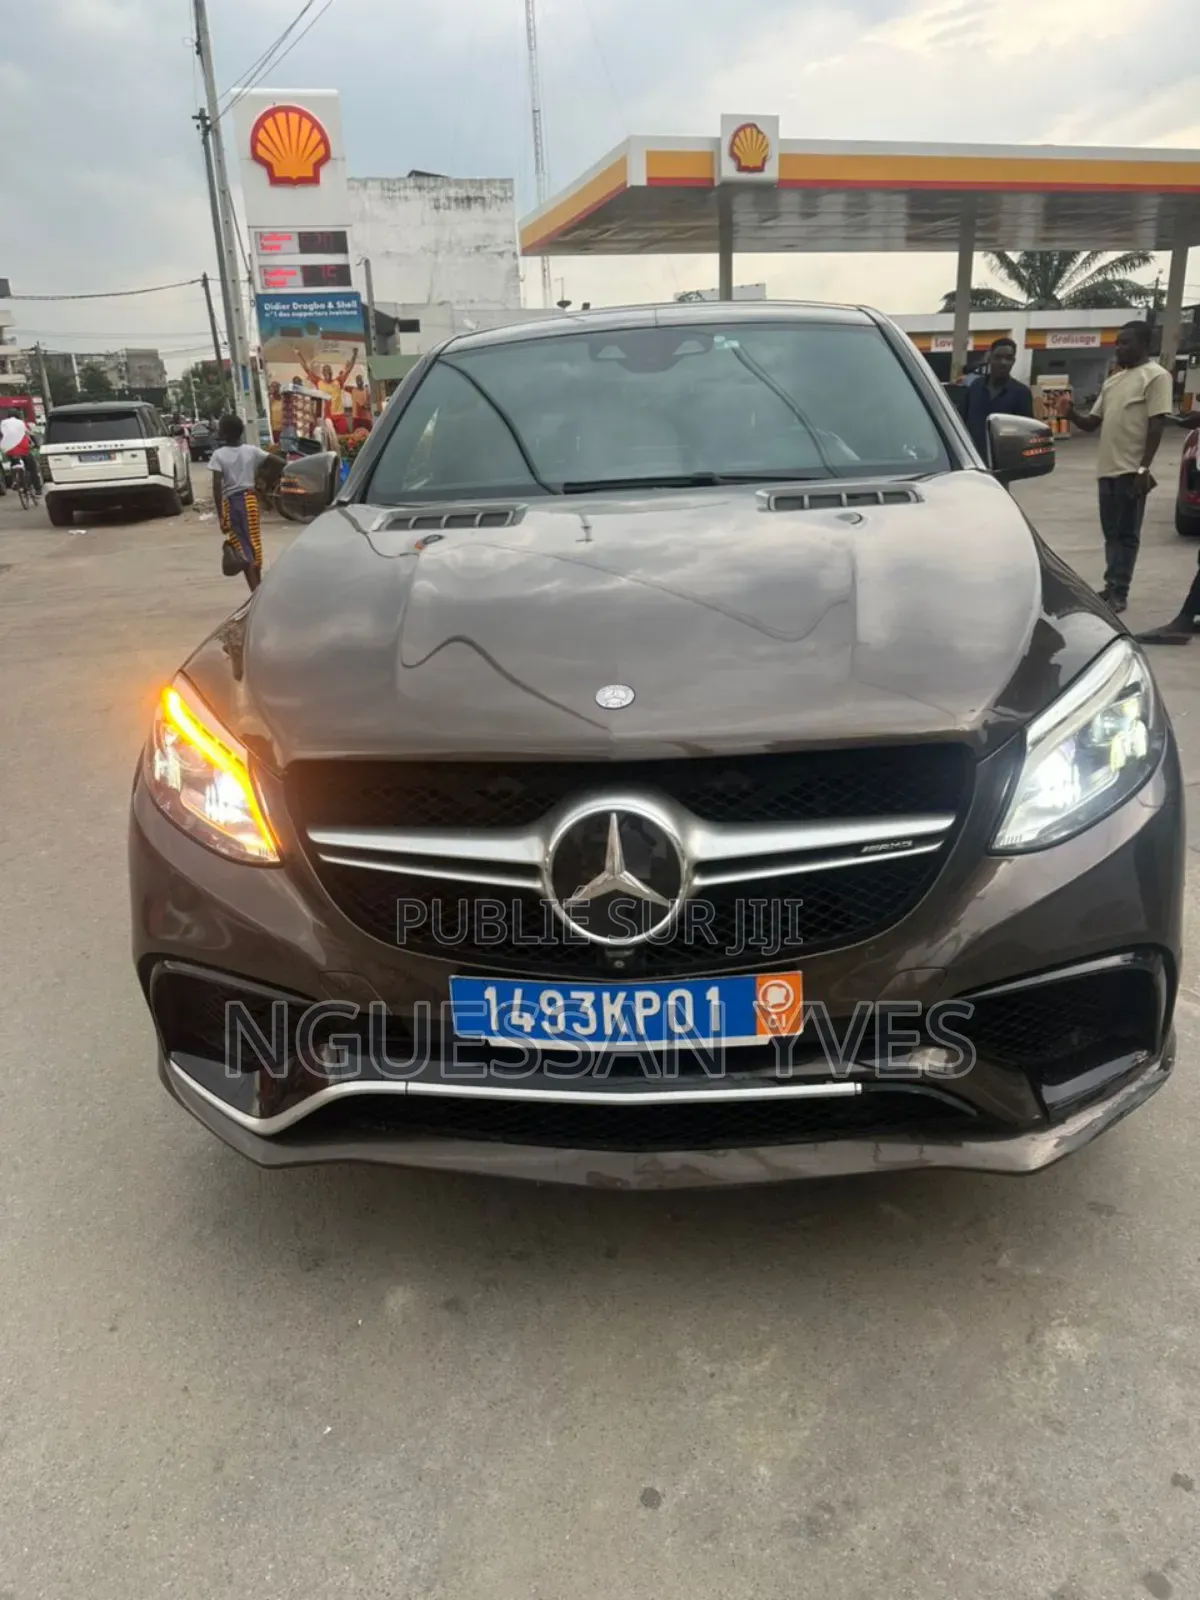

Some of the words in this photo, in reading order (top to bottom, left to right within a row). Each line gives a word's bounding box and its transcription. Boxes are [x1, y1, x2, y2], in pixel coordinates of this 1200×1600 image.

[264, 302, 290, 311] Didier
[292, 301, 325, 311] Drogba
[327, 301, 334, 309] &
[336, 301, 358, 309] Shell
[1051, 334, 1097, 346] Graissage
[483, 985, 720, 1036] 1493KP01
